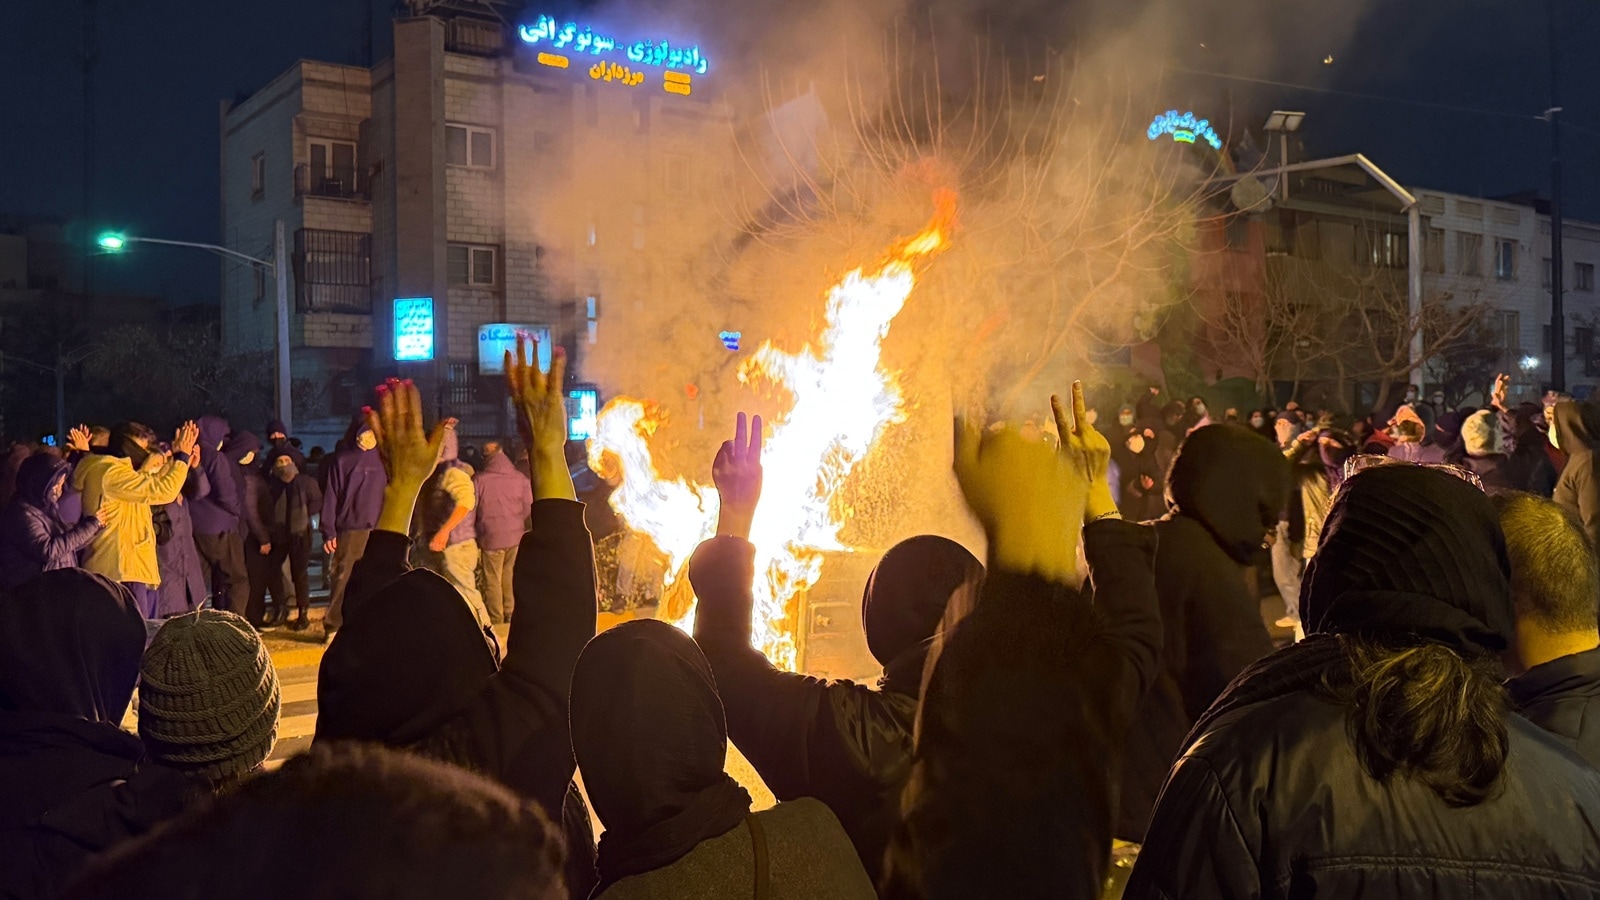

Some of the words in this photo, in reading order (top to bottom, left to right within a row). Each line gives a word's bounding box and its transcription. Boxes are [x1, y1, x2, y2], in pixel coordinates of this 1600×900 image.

[518, 14, 615, 56] سونوگرافی
[589, 60, 645, 86] مرزداران
[627, 38, 708, 75] رادیولوژی
